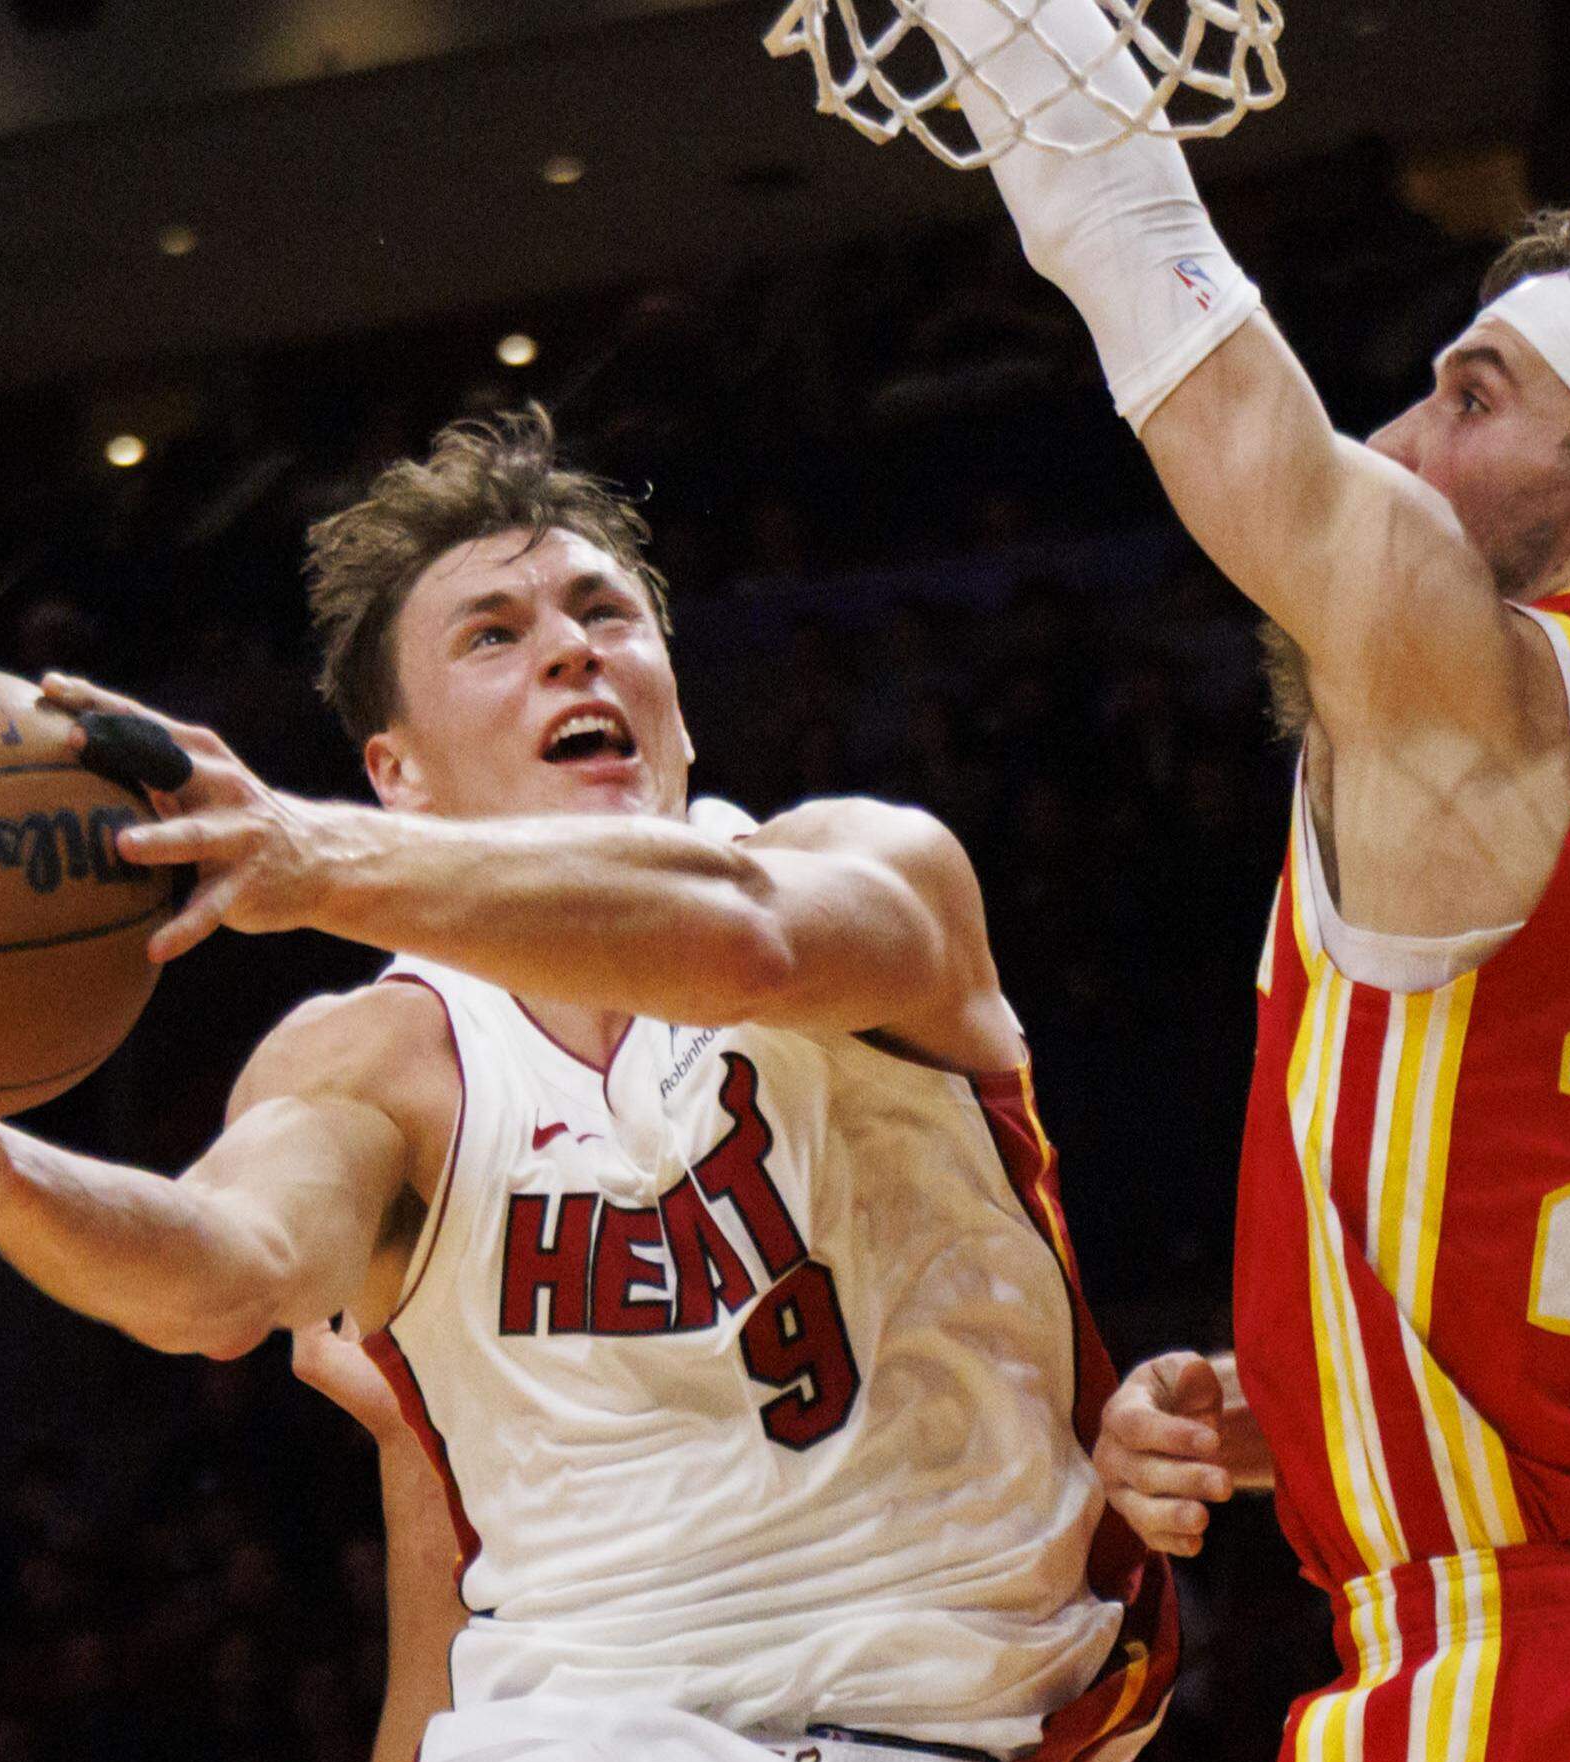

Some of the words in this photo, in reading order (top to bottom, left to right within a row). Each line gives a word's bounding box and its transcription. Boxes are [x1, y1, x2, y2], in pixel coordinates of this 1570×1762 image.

[660, 1027, 722, 1098] Robinho
[499, 1051, 810, 1337] HEAT
[738, 1256, 862, 1452] 9
